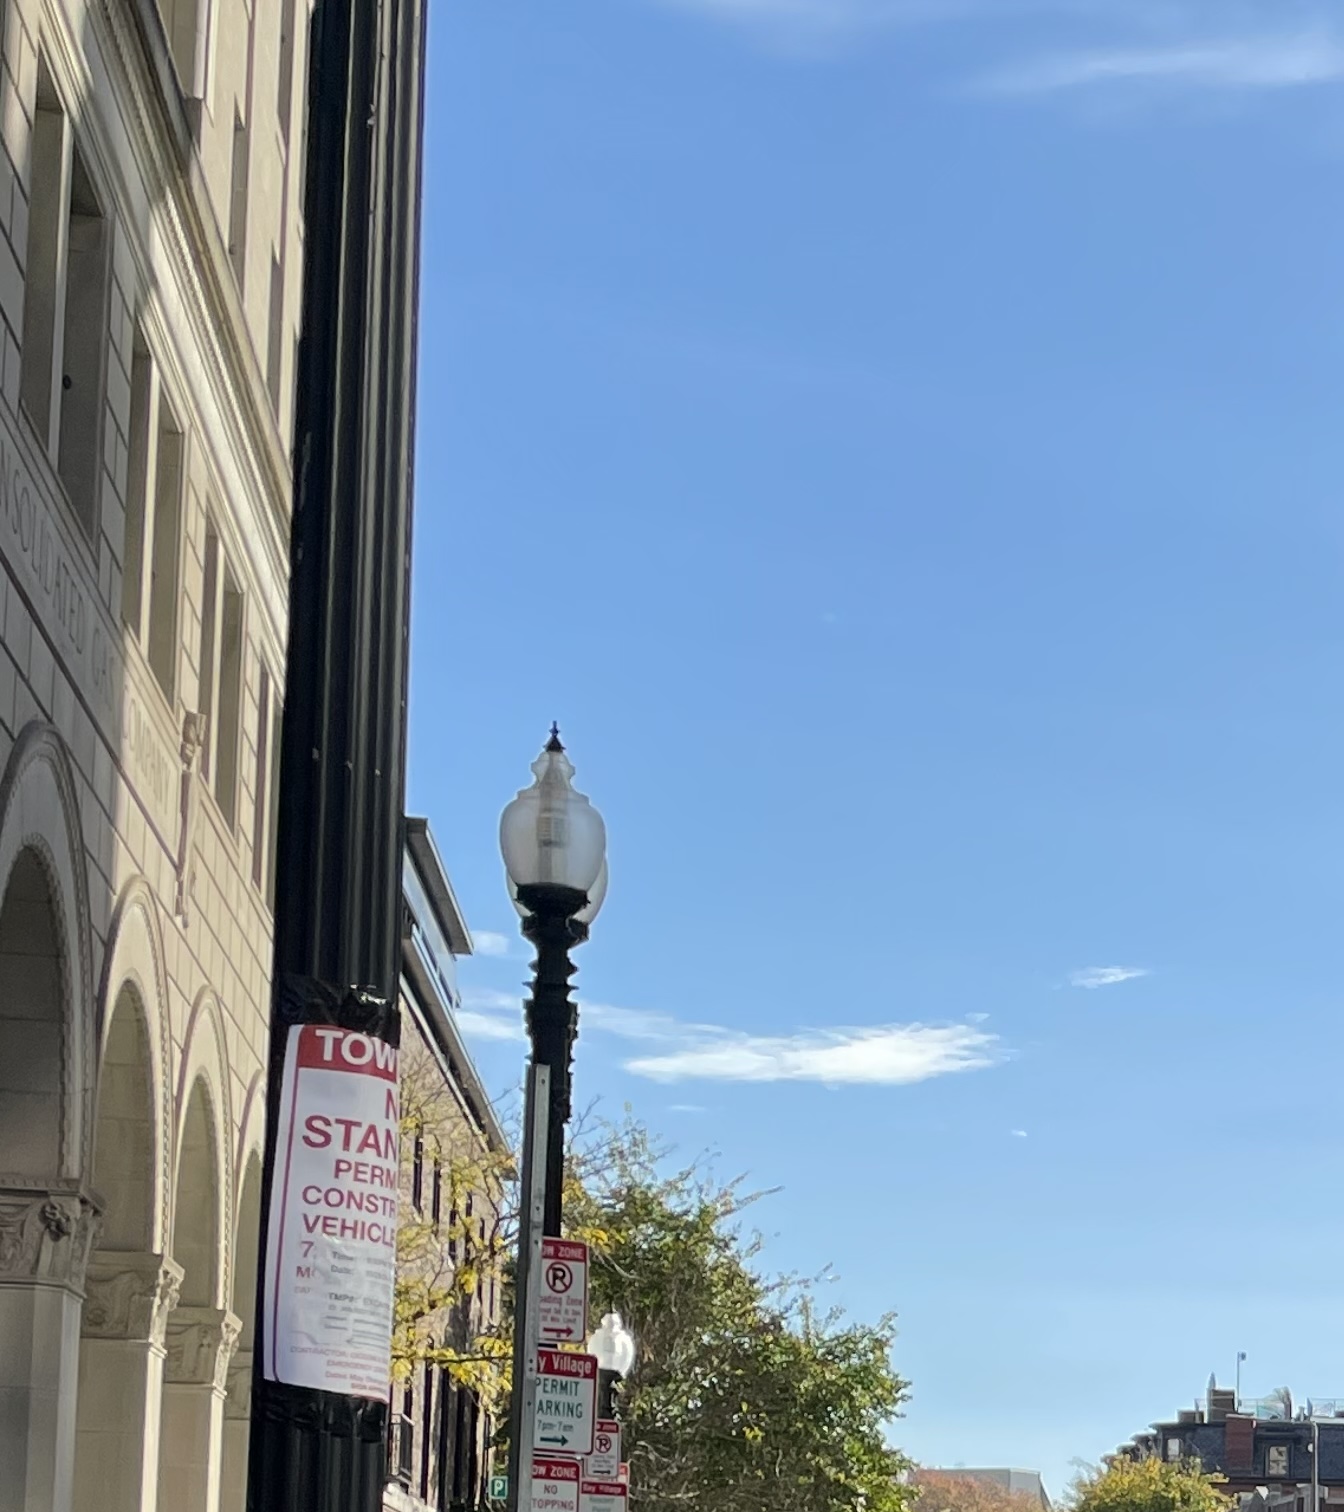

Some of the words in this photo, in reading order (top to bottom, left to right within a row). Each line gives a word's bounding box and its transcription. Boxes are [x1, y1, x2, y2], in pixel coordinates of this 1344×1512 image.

[314, 1028, 396, 1073] TOW
[542, 1245, 554, 1256] OW
[552, 1354, 592, 1378] Village
[537, 1399, 583, 1419] ARKING
[532, 1464, 546, 1476] OW
[550, 1465, 577, 1478] ZONE
[543, 1484, 558, 1495] NO
[533, 1498, 575, 1511] TOPPING
